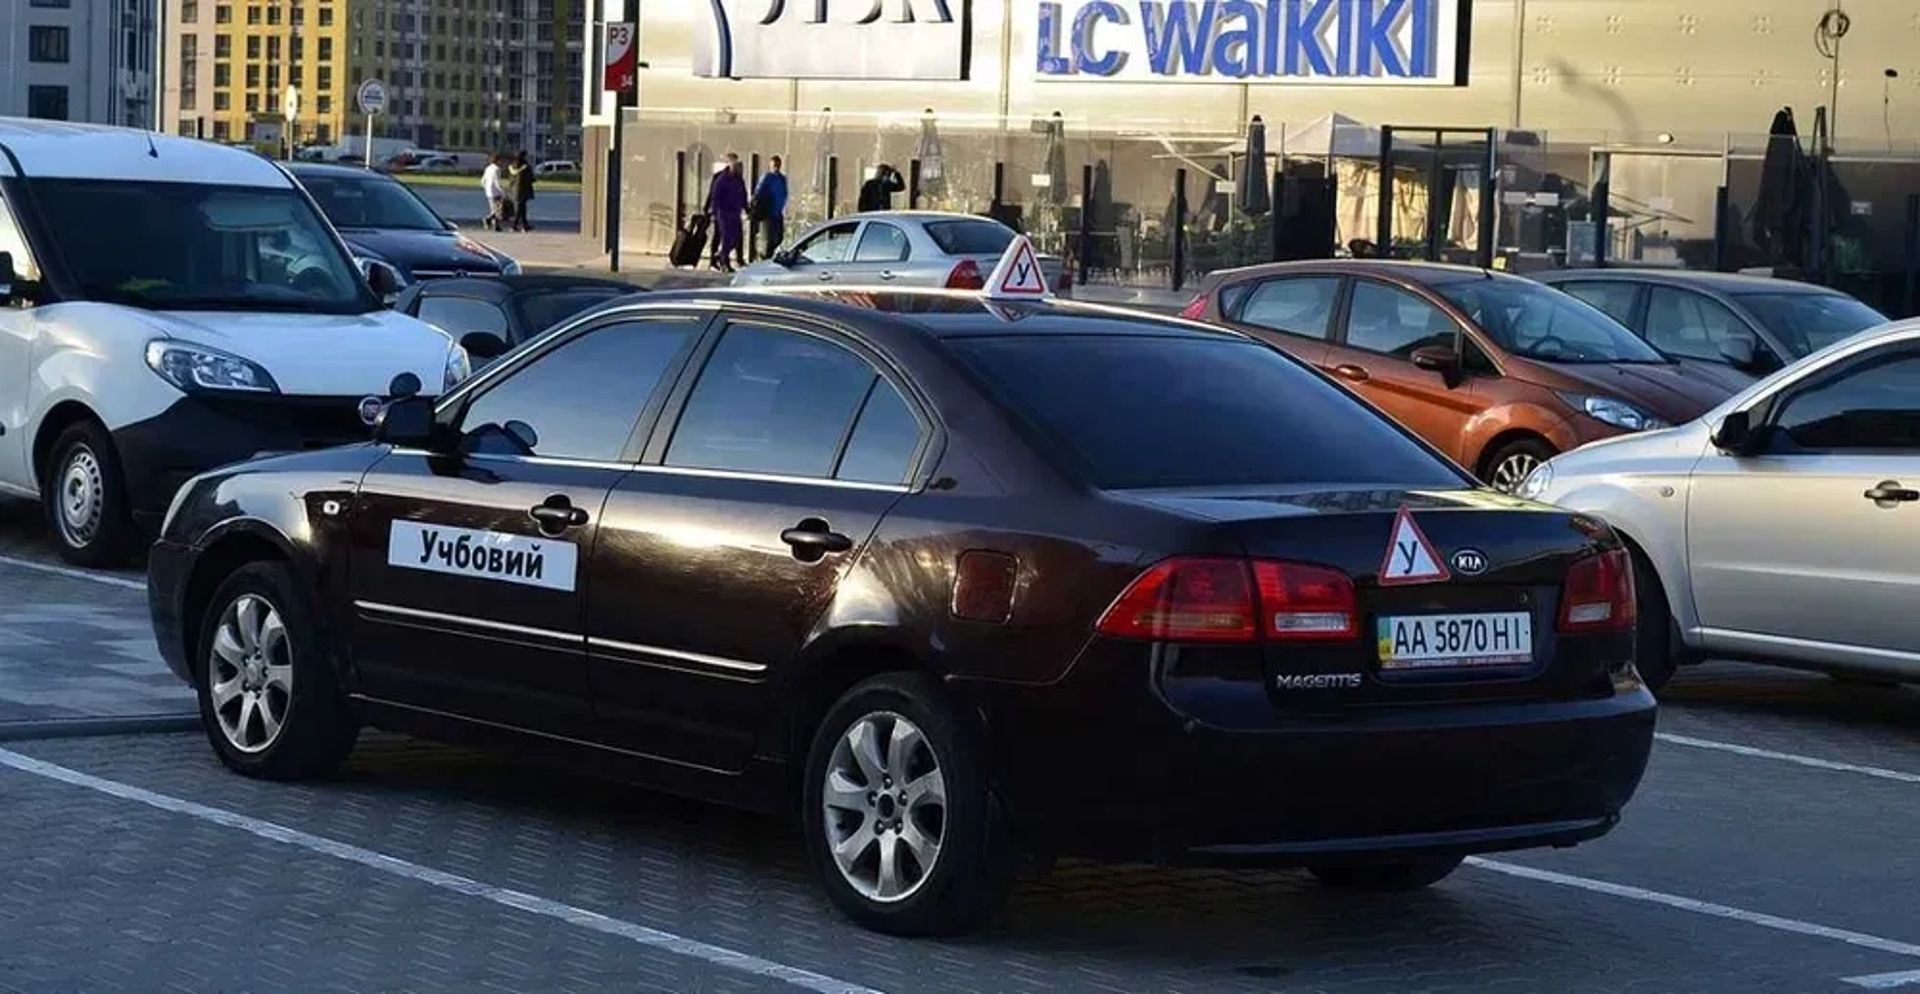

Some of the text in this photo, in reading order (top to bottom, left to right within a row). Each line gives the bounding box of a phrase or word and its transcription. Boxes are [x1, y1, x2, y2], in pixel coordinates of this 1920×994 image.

[610, 26, 629, 46] P3
[1036, 0, 1131, 76] LC
[420, 529, 543, 579] Учбовий
[1457, 555, 1483, 570] KIA
[1394, 621, 1428, 654] AA
[1434, 619, 1488, 653] 5870
